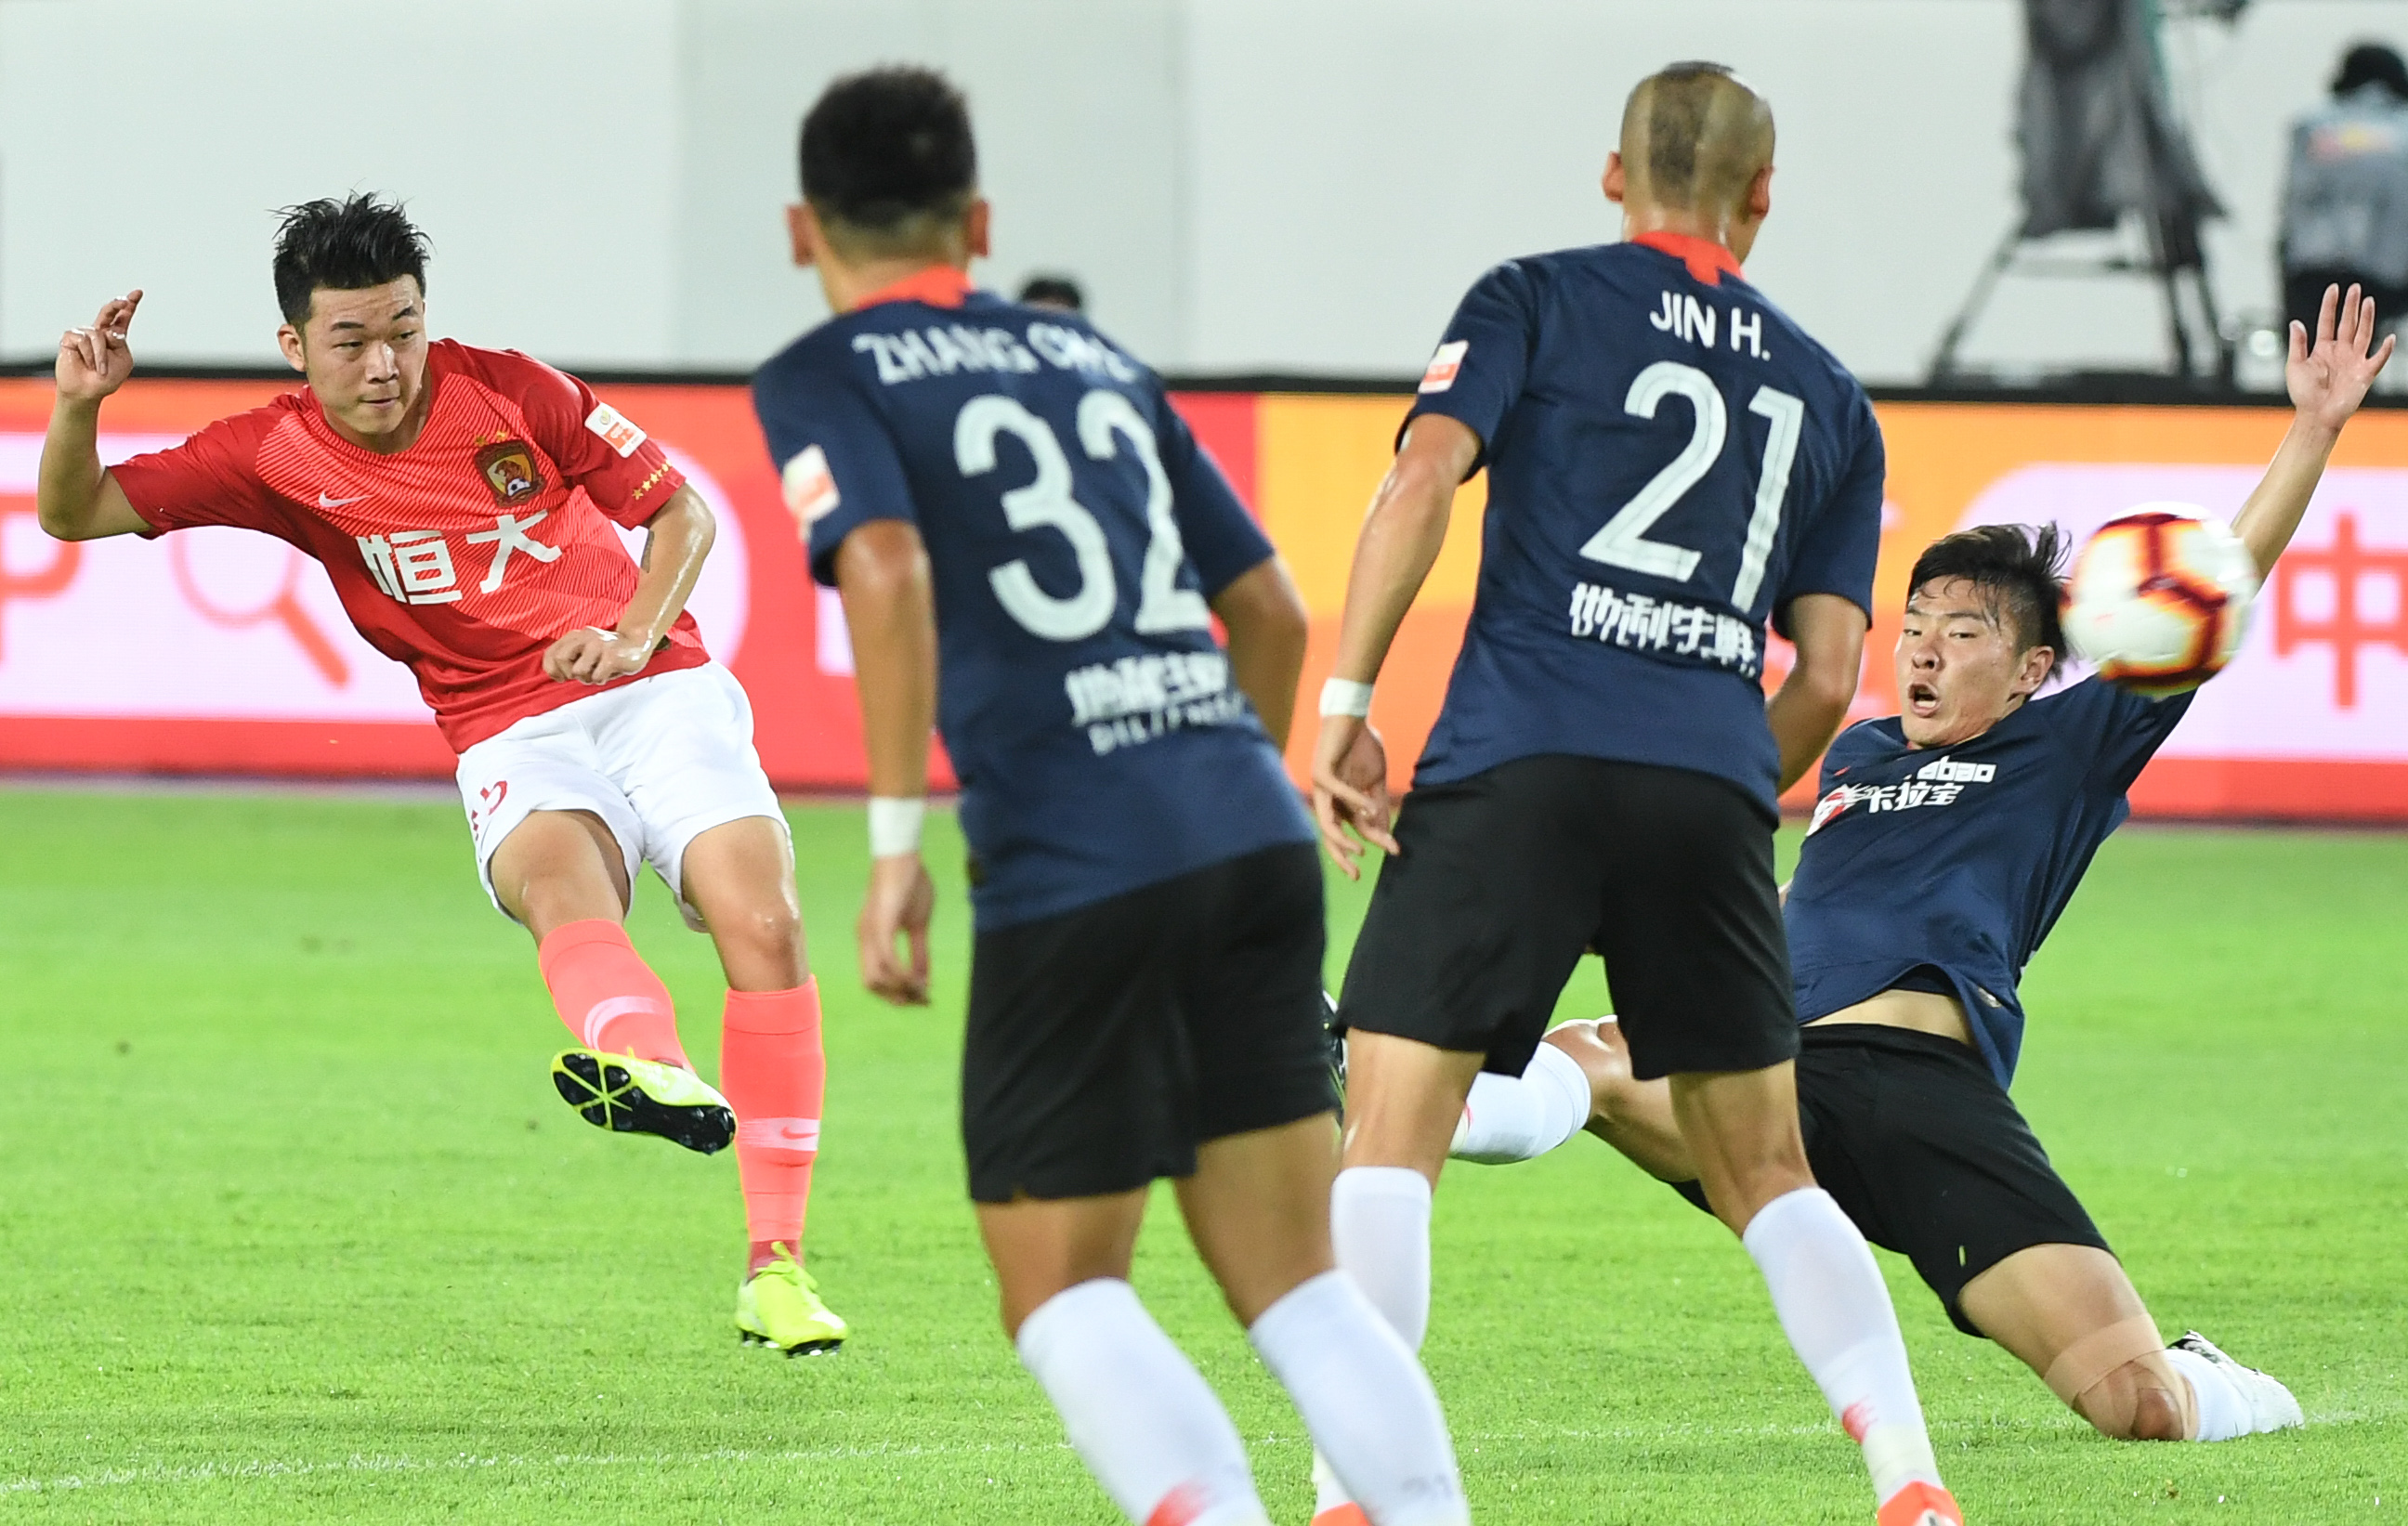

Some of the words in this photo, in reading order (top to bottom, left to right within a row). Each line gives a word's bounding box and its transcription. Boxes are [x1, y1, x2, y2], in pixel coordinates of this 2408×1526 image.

[852, 324, 1040, 385] ZHANG
[1650, 290, 1716, 347] JIN
[1730, 307, 1771, 360] H.
[356, 513, 563, 606] 恒大
[954, 388, 1211, 641] 32
[1578, 360, 1804, 615] 21
[2275, 514, 2408, 709] 中
